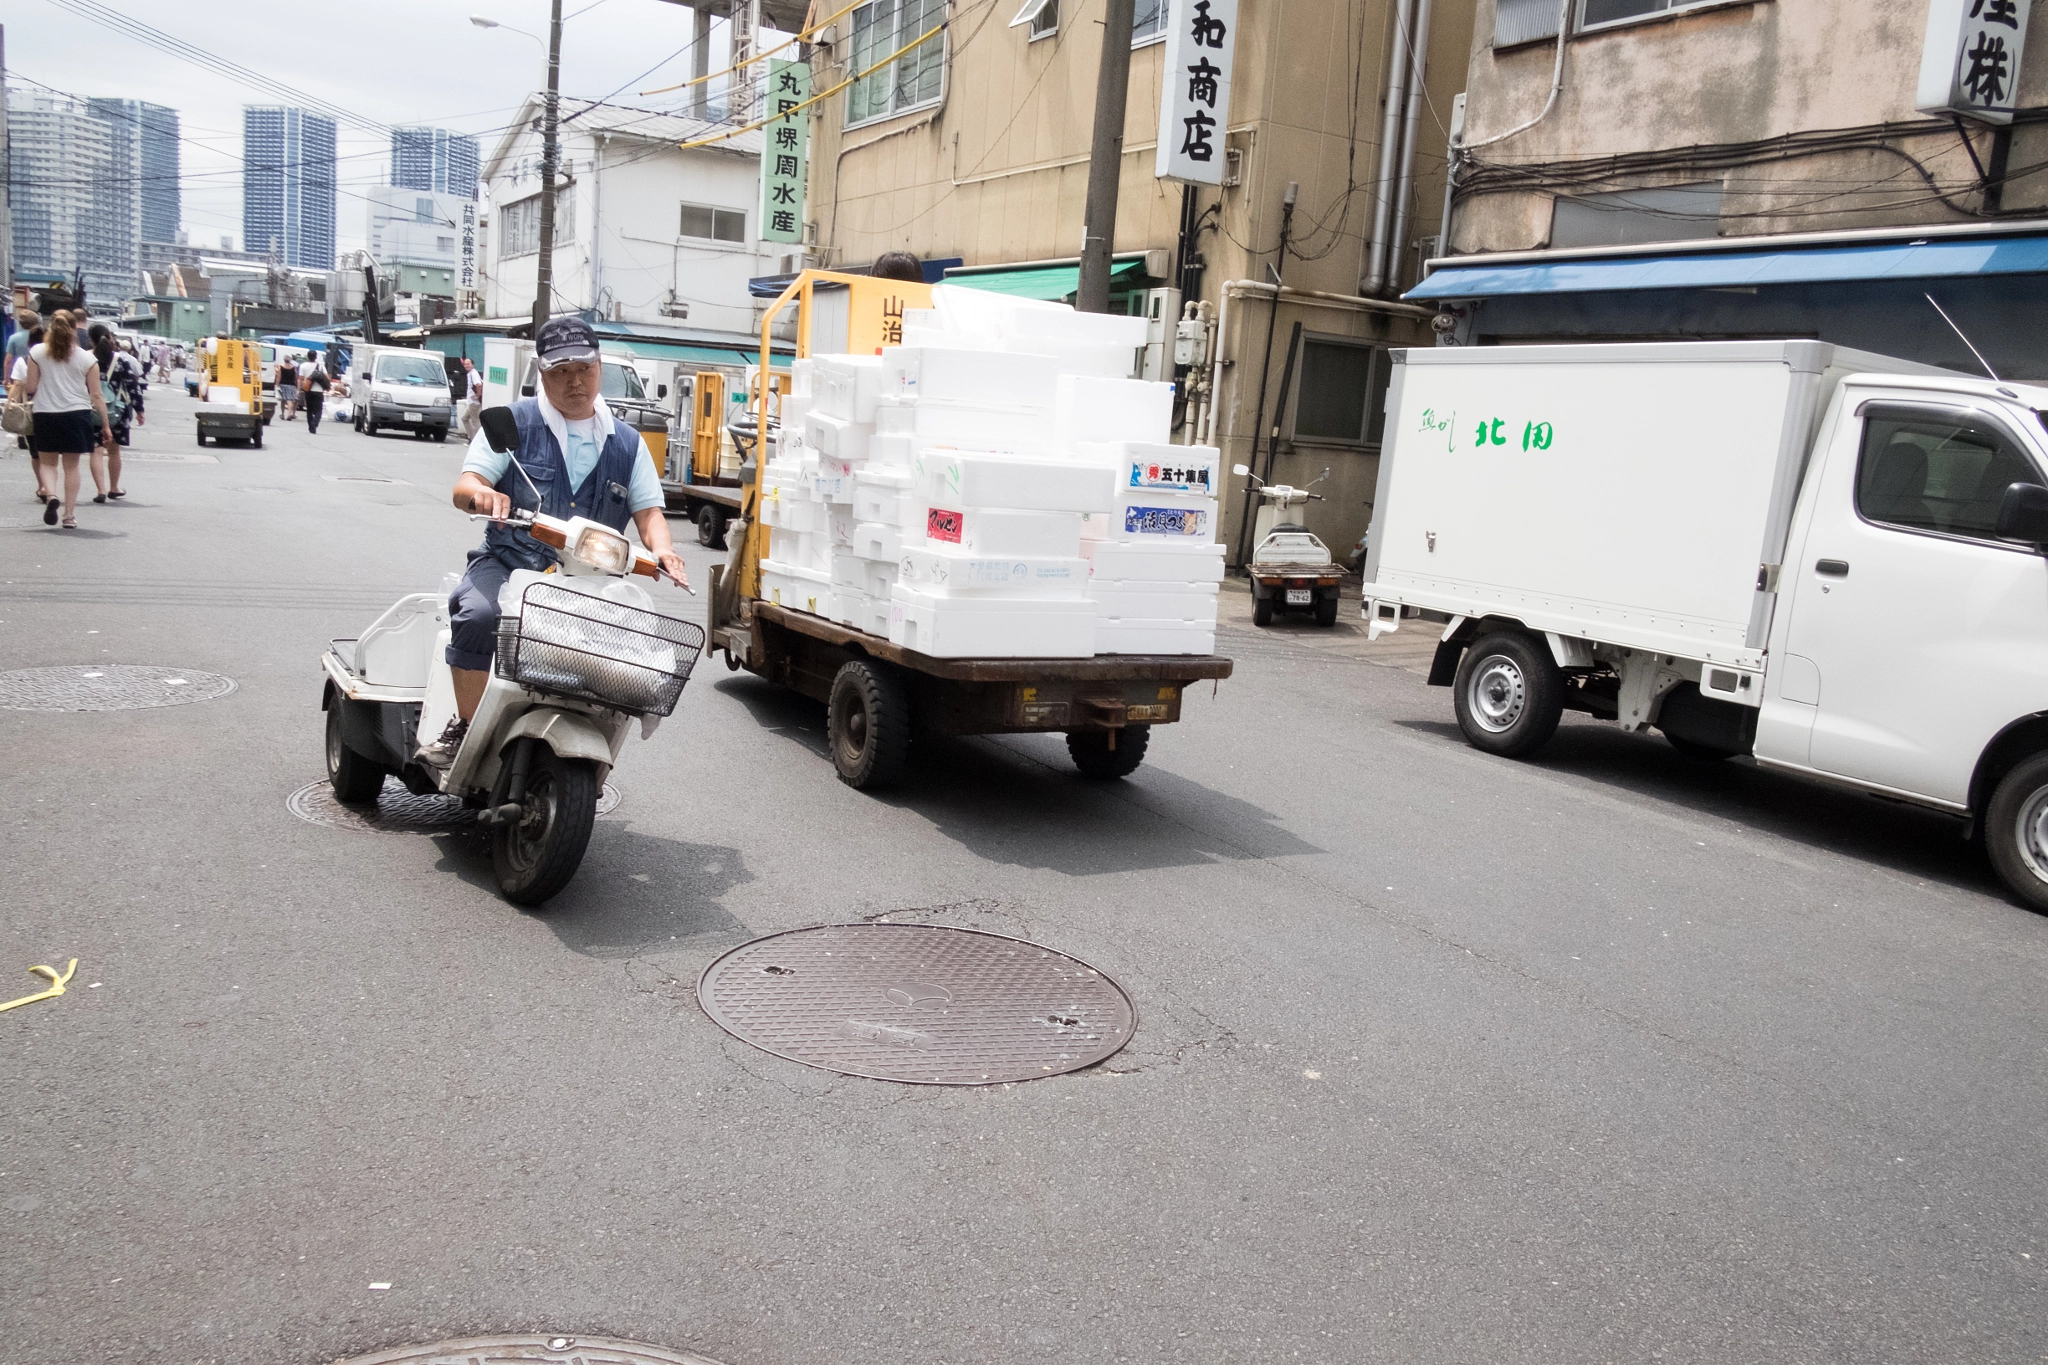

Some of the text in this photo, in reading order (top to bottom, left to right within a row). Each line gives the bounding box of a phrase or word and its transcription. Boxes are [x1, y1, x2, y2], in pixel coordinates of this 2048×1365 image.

[461, 203, 475, 287] 共同水産株式会社
